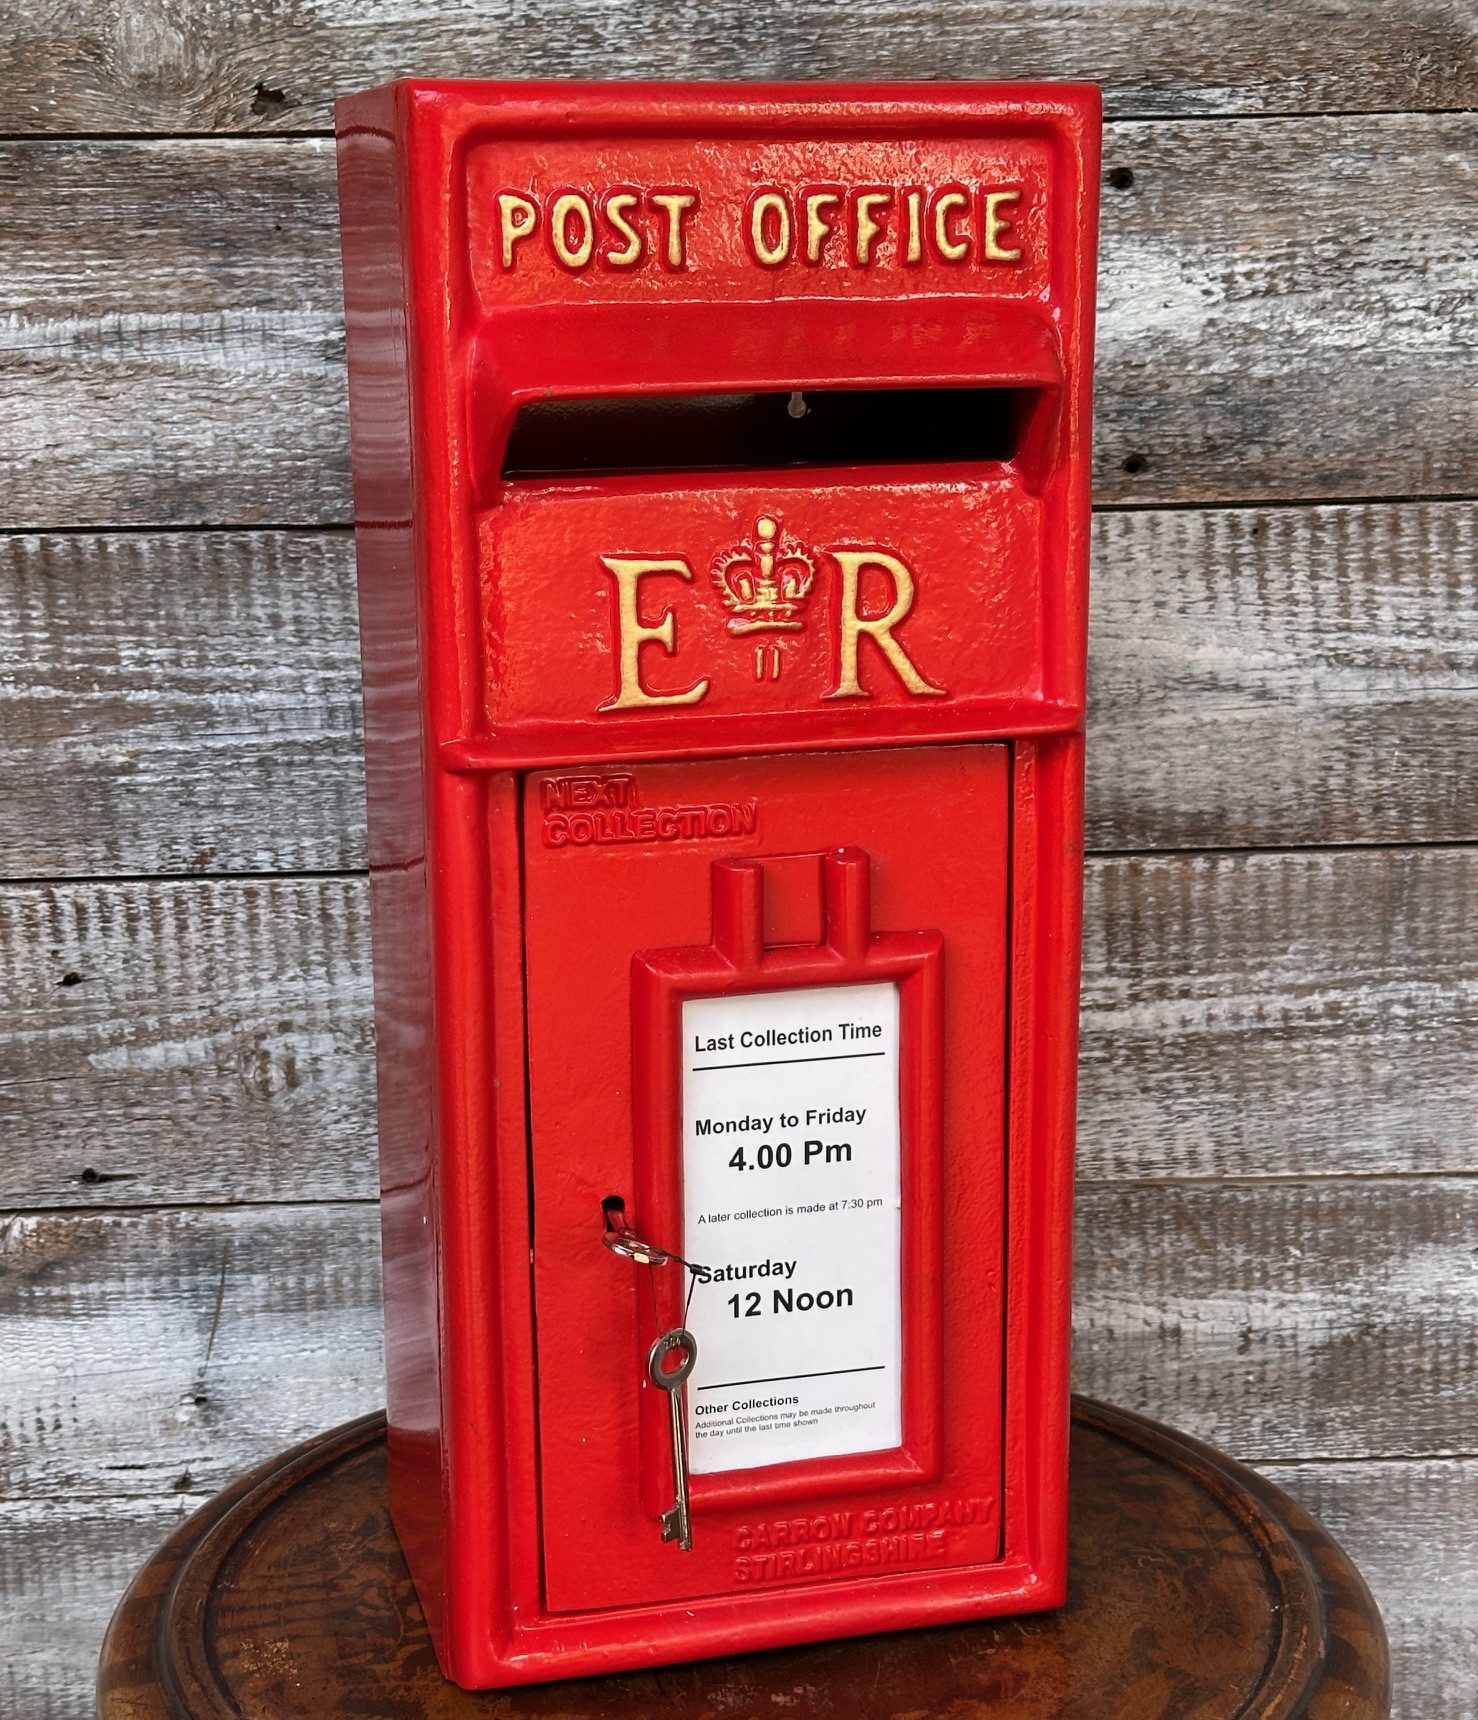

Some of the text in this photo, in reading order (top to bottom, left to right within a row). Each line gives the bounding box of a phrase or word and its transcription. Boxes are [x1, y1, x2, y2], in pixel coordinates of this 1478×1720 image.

[498, 190, 1022, 268] POST OFFICE
[598, 551, 948, 712] E R
[754, 647, 780, 680] II
[541, 775, 636, 809] NEXT
[543, 802, 759, 847] COLLECTION
[694, 1023, 883, 1052] Last Collection Time
[694, 1107, 867, 1136] Monday to Friday
[728, 1140, 852, 1172] 4.00 Pm
[697, 1198, 884, 1224] A later collection is made at 7:30 pm
[697, 1258, 798, 1285] Saturday
[727, 1287, 854, 1319] 12 Noon
[695, 1395, 800, 1416] Other Collections
[695, 1401, 876, 1430] Additional Collections may be made throughout
[695, 1417, 819, 1439] the day until the last time shown
[863, 1496, 994, 1535] COMPANY
[734, 1529, 946, 1582] STIRLINGSHIRE
